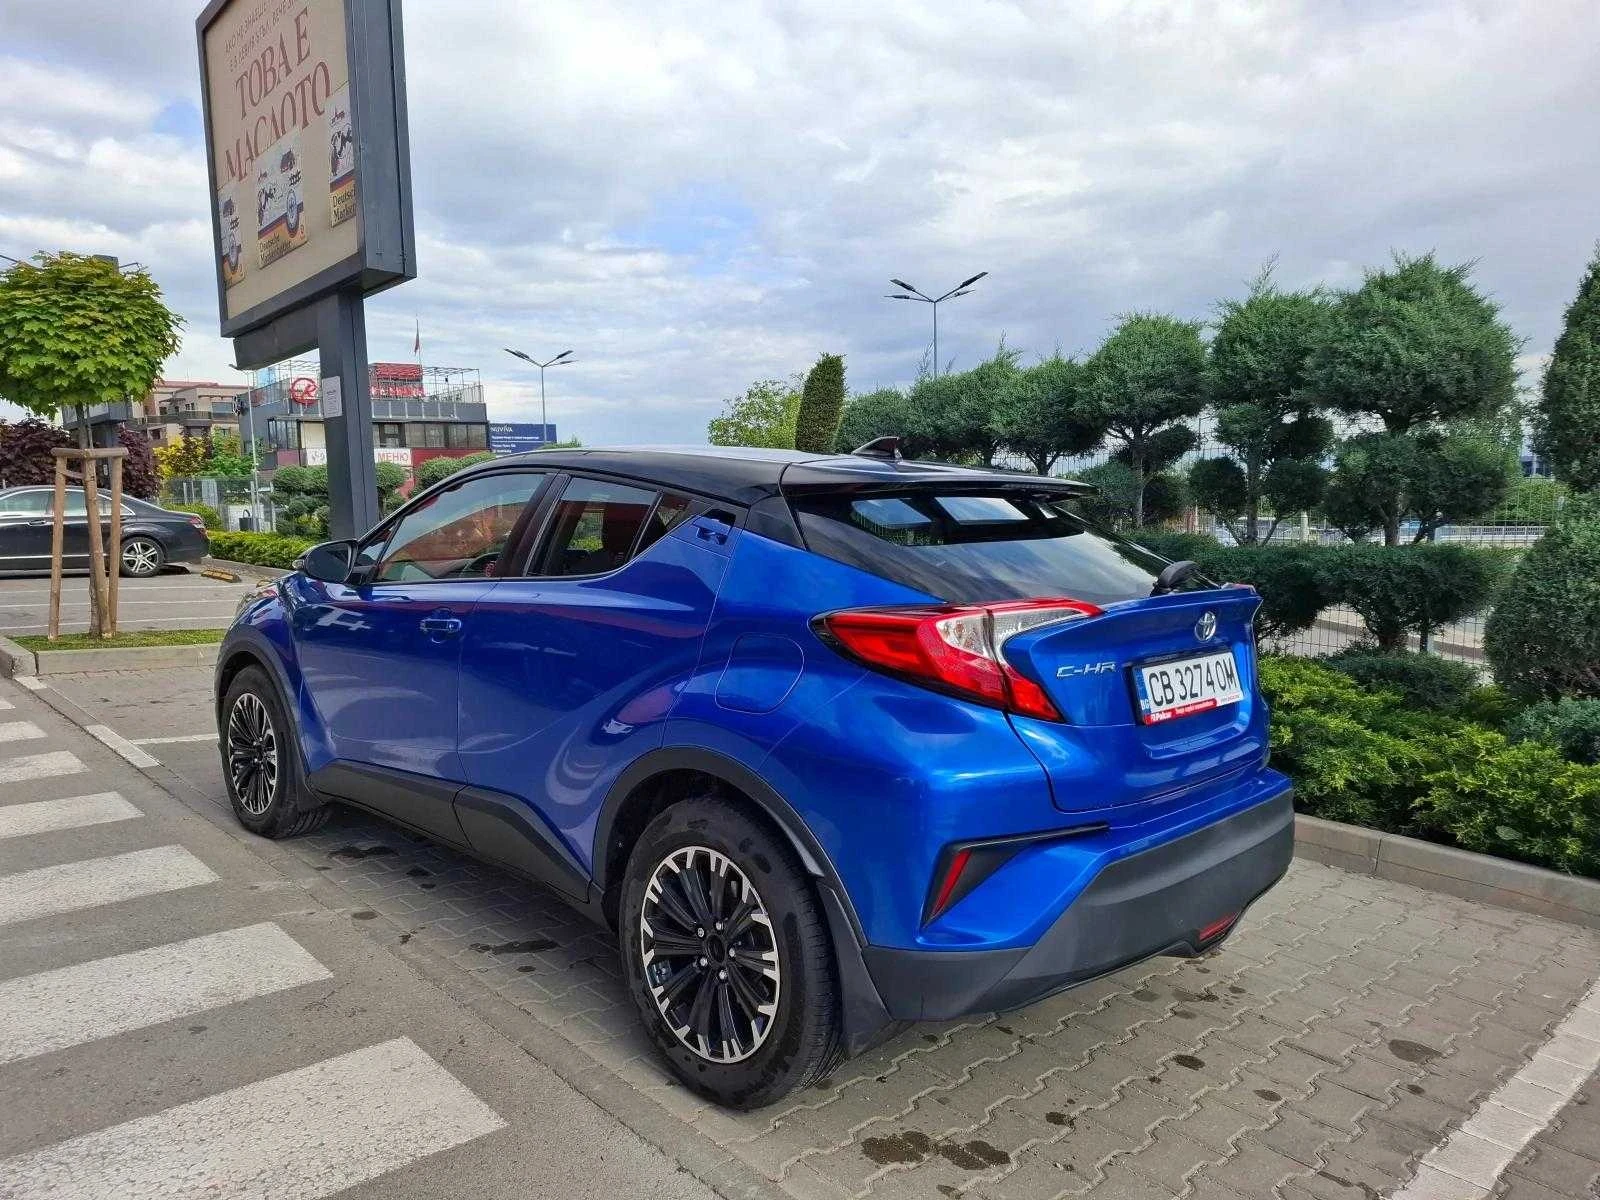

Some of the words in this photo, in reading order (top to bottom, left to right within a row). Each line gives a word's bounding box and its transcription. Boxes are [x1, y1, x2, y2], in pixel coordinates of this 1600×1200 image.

[235, 32, 293, 120] ТОВА
[294, 7, 311, 66] Е
[225, 61, 331, 182] МАСЛОТО
[378, 452, 409, 462] МЕНЮ
[1056, 661, 1117, 678] C-HR
[1149, 669, 1175, 707] CB
[1175, 664, 1216, 701] 3274
[1214, 657, 1238, 691] OM
